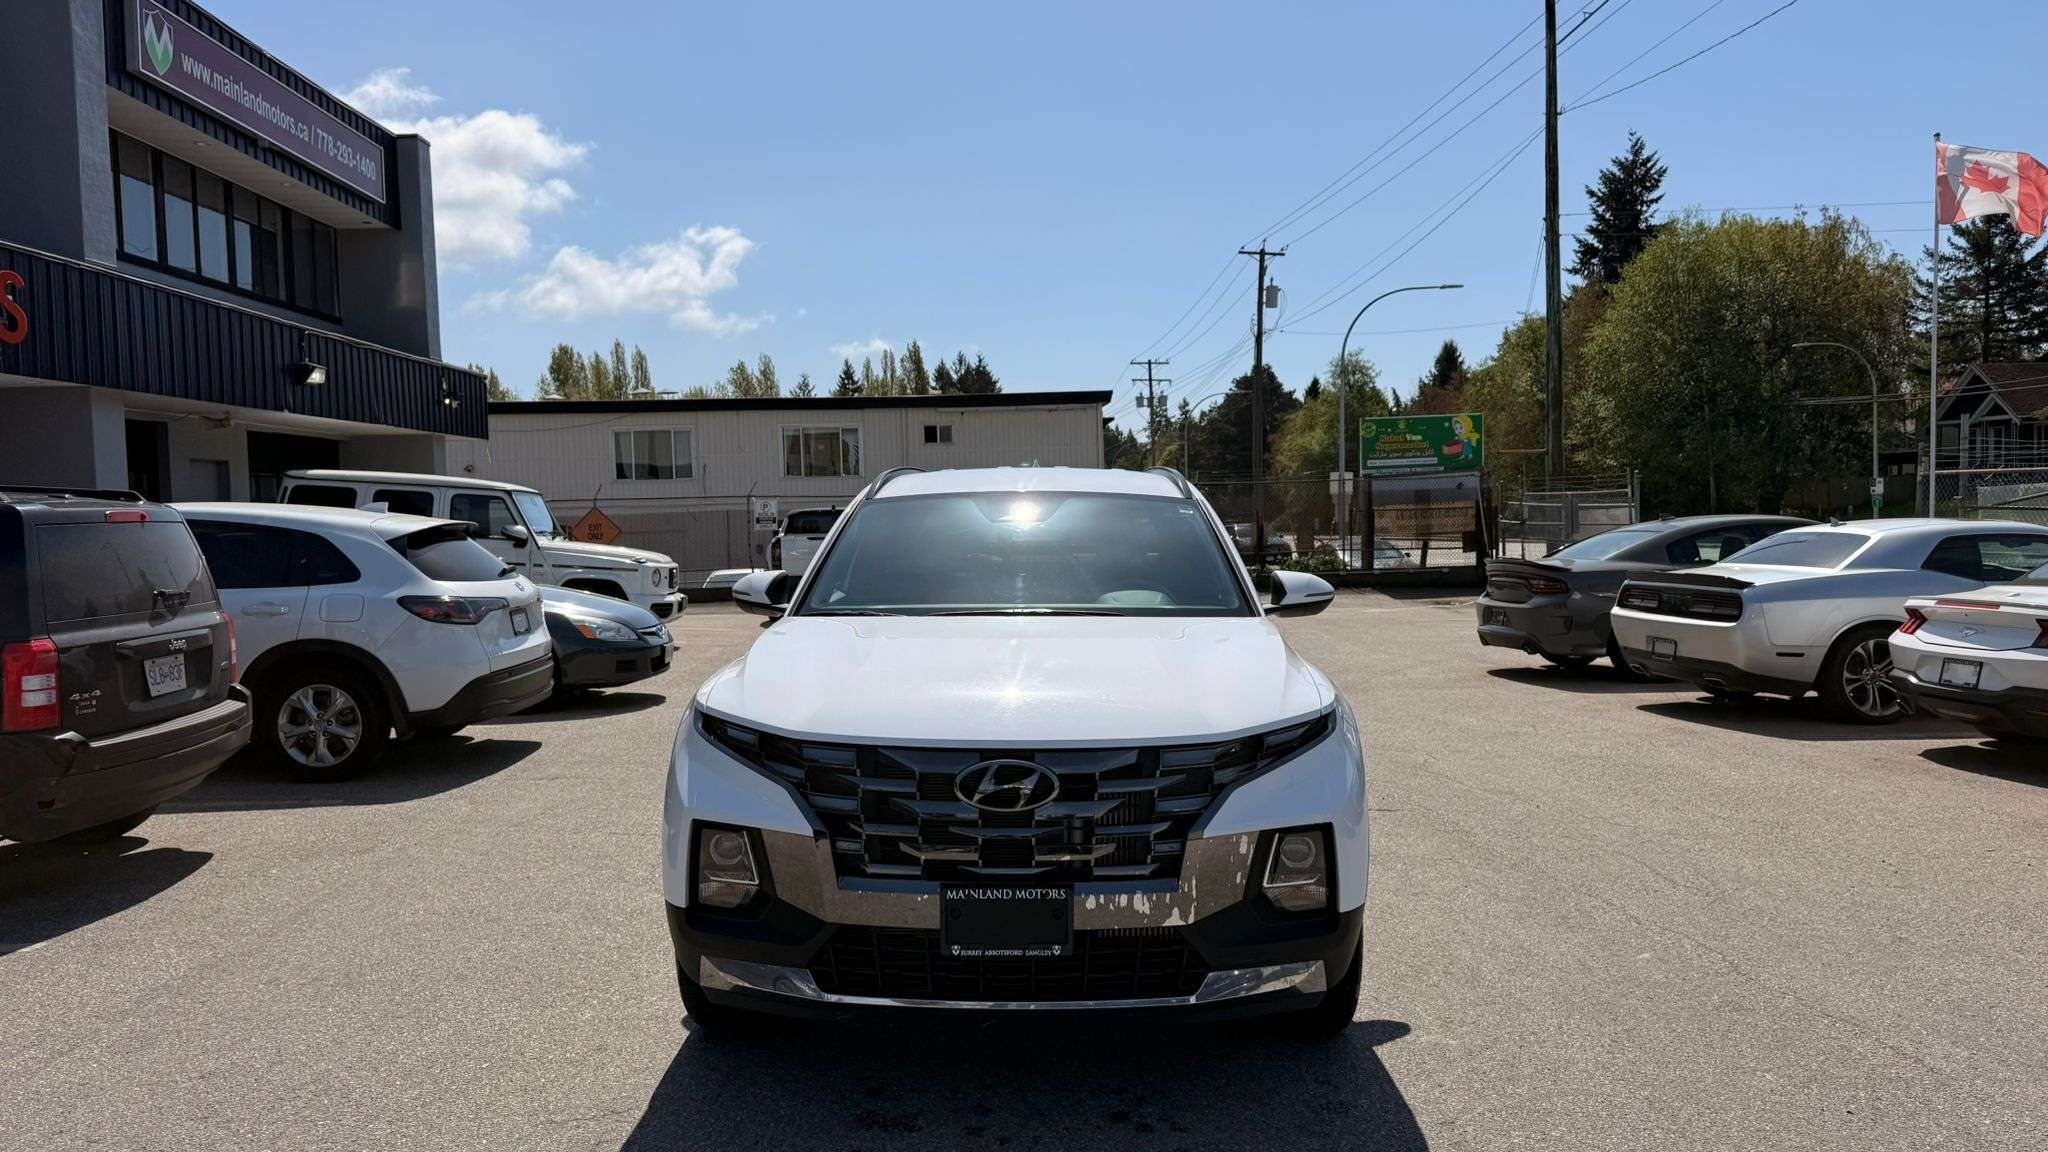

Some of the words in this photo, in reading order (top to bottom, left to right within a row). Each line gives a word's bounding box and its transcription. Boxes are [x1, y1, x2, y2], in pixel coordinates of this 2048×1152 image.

[181, 53, 309, 142] www.mainlandmotors.ca
[316, 128, 376, 181] 778-293-1400
[0, 269, 28, 344] S
[588, 522, 603, 531] EXIT
[168, 639, 188, 650] Jeep
